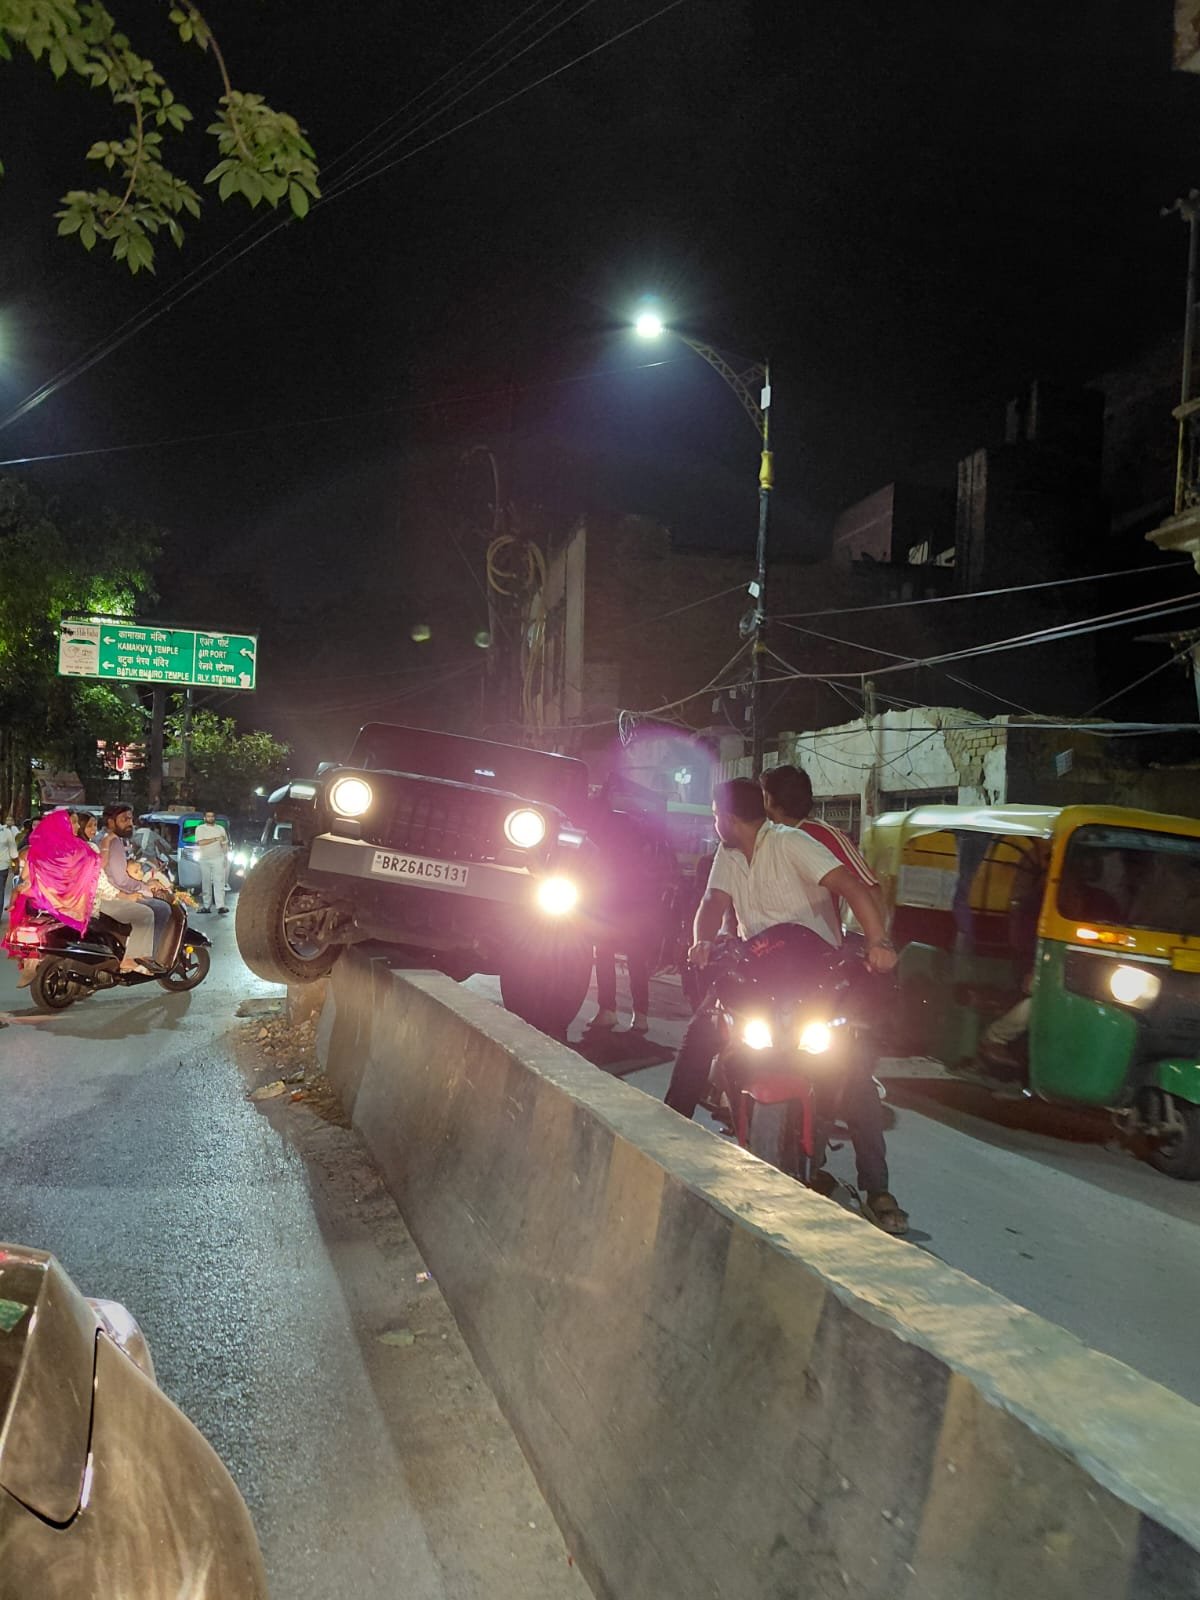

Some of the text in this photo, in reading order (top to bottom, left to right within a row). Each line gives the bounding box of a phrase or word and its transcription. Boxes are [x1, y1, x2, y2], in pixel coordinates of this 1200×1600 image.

[117, 642, 179, 655] KAMAKHYA TEMPLE
[199, 649, 226, 659] AIR PORT
[117, 667, 190, 681] BATUK BHAIRO TEMPLE
[211, 674, 236, 684] STATION
[382, 856, 467, 883] BR26AC5131
